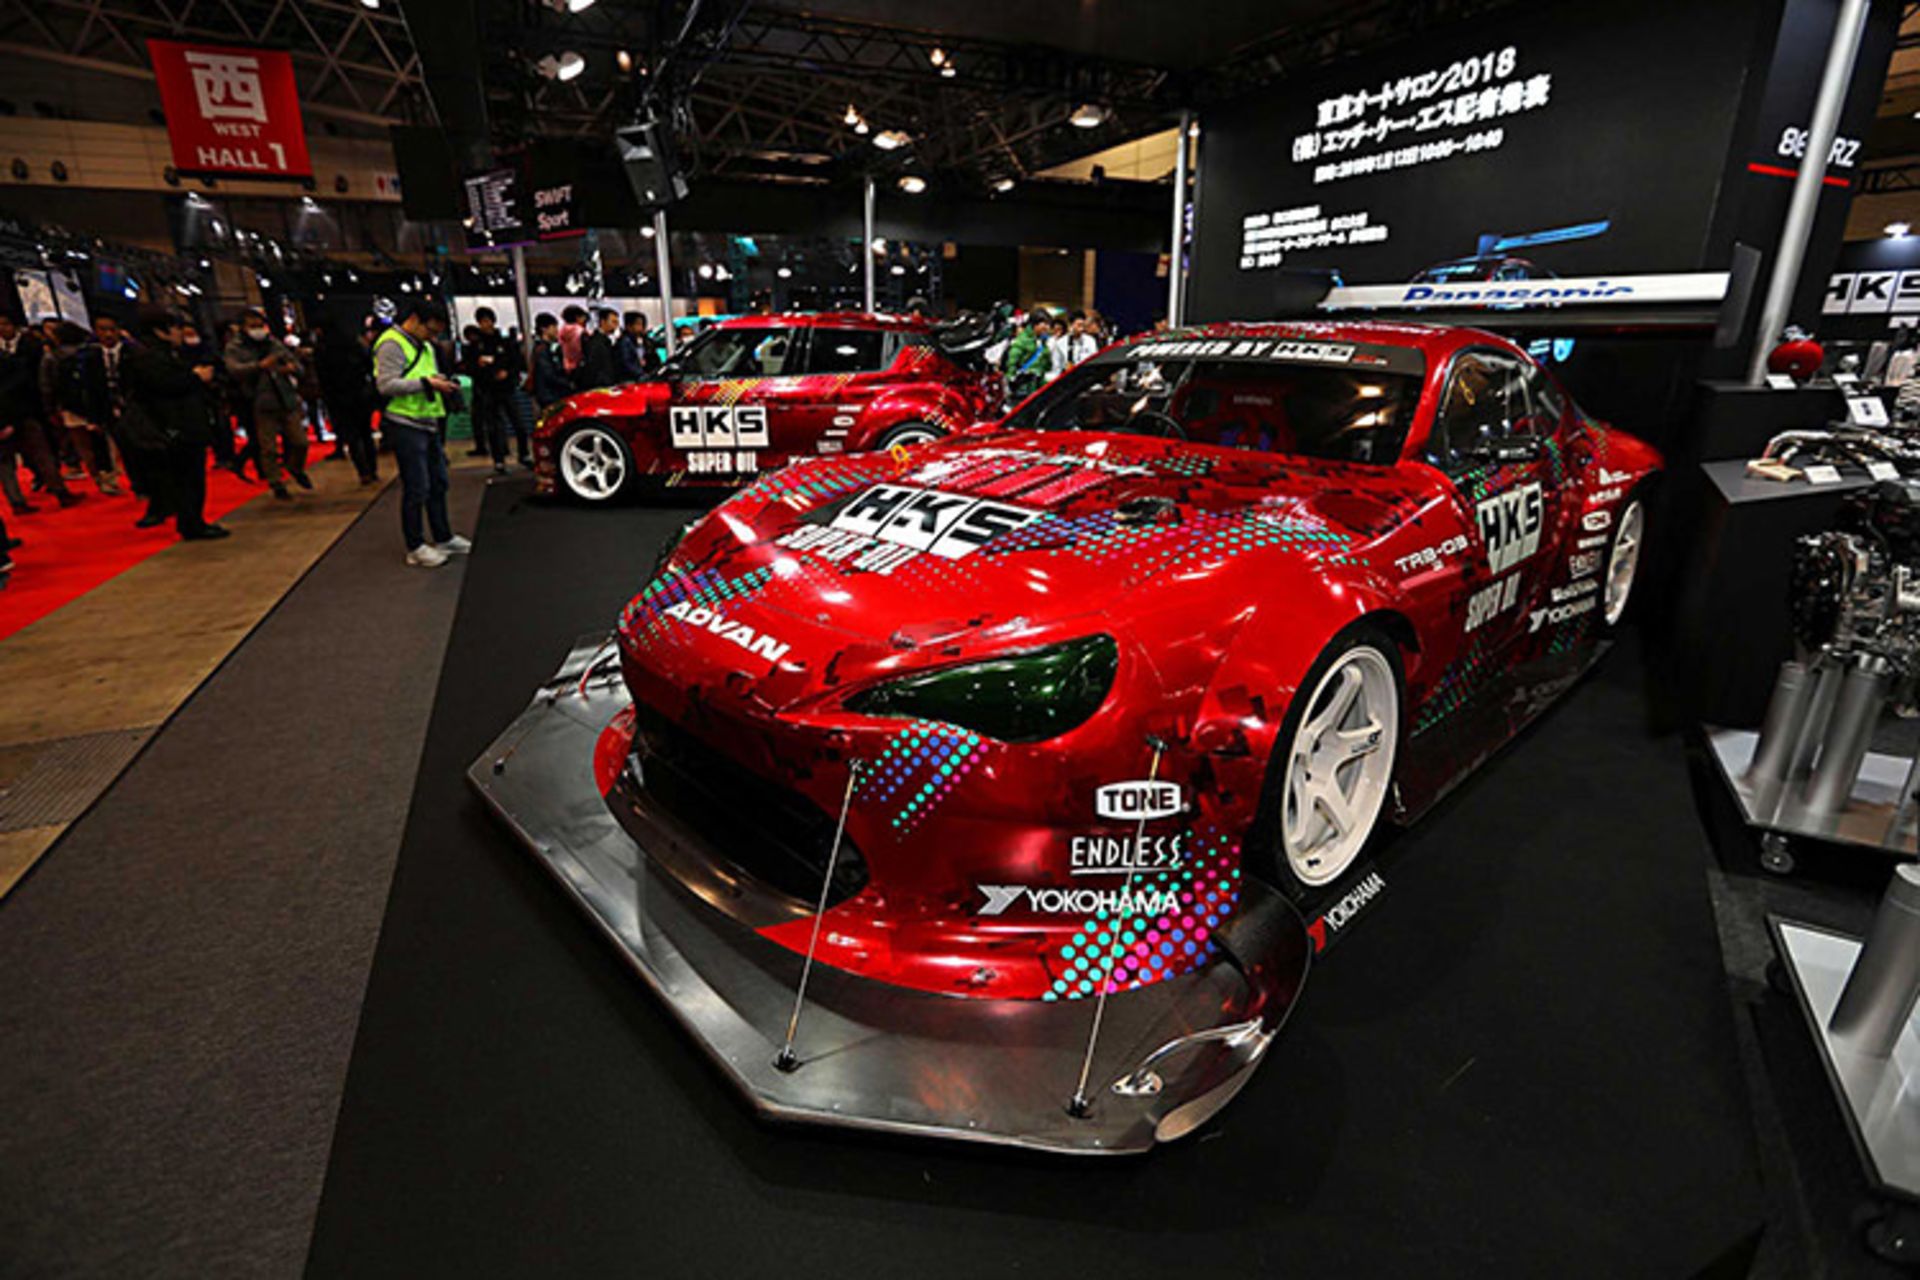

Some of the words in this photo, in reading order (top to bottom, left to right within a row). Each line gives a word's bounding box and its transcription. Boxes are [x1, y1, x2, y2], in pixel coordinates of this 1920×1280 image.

[184, 51, 269, 123] 西
[212, 122, 261, 137] WEST
[197, 146, 268, 170] HALL
[268, 142, 288, 170] 1
[1826, 137, 1861, 167] RZ
[1402, 281, 1635, 301] Panasonic
[1230, 341, 1272, 356] BY
[1273, 342, 1353, 360] HKS
[672, 409, 766, 438] HKS
[687, 452, 732, 473] SUPER
[736, 452, 758, 473] OIL
[841, 486, 1034, 548] HKS
[1480, 487, 1540, 555] HKS
[663, 601, 791, 662] ADVAN
[1101, 786, 1177, 814] TONE
[1071, 834, 1183, 869] ENDLESS
[1026, 889, 1182, 914] YOKOHAMA
[1322, 872, 1386, 931] YOKOHAMA
